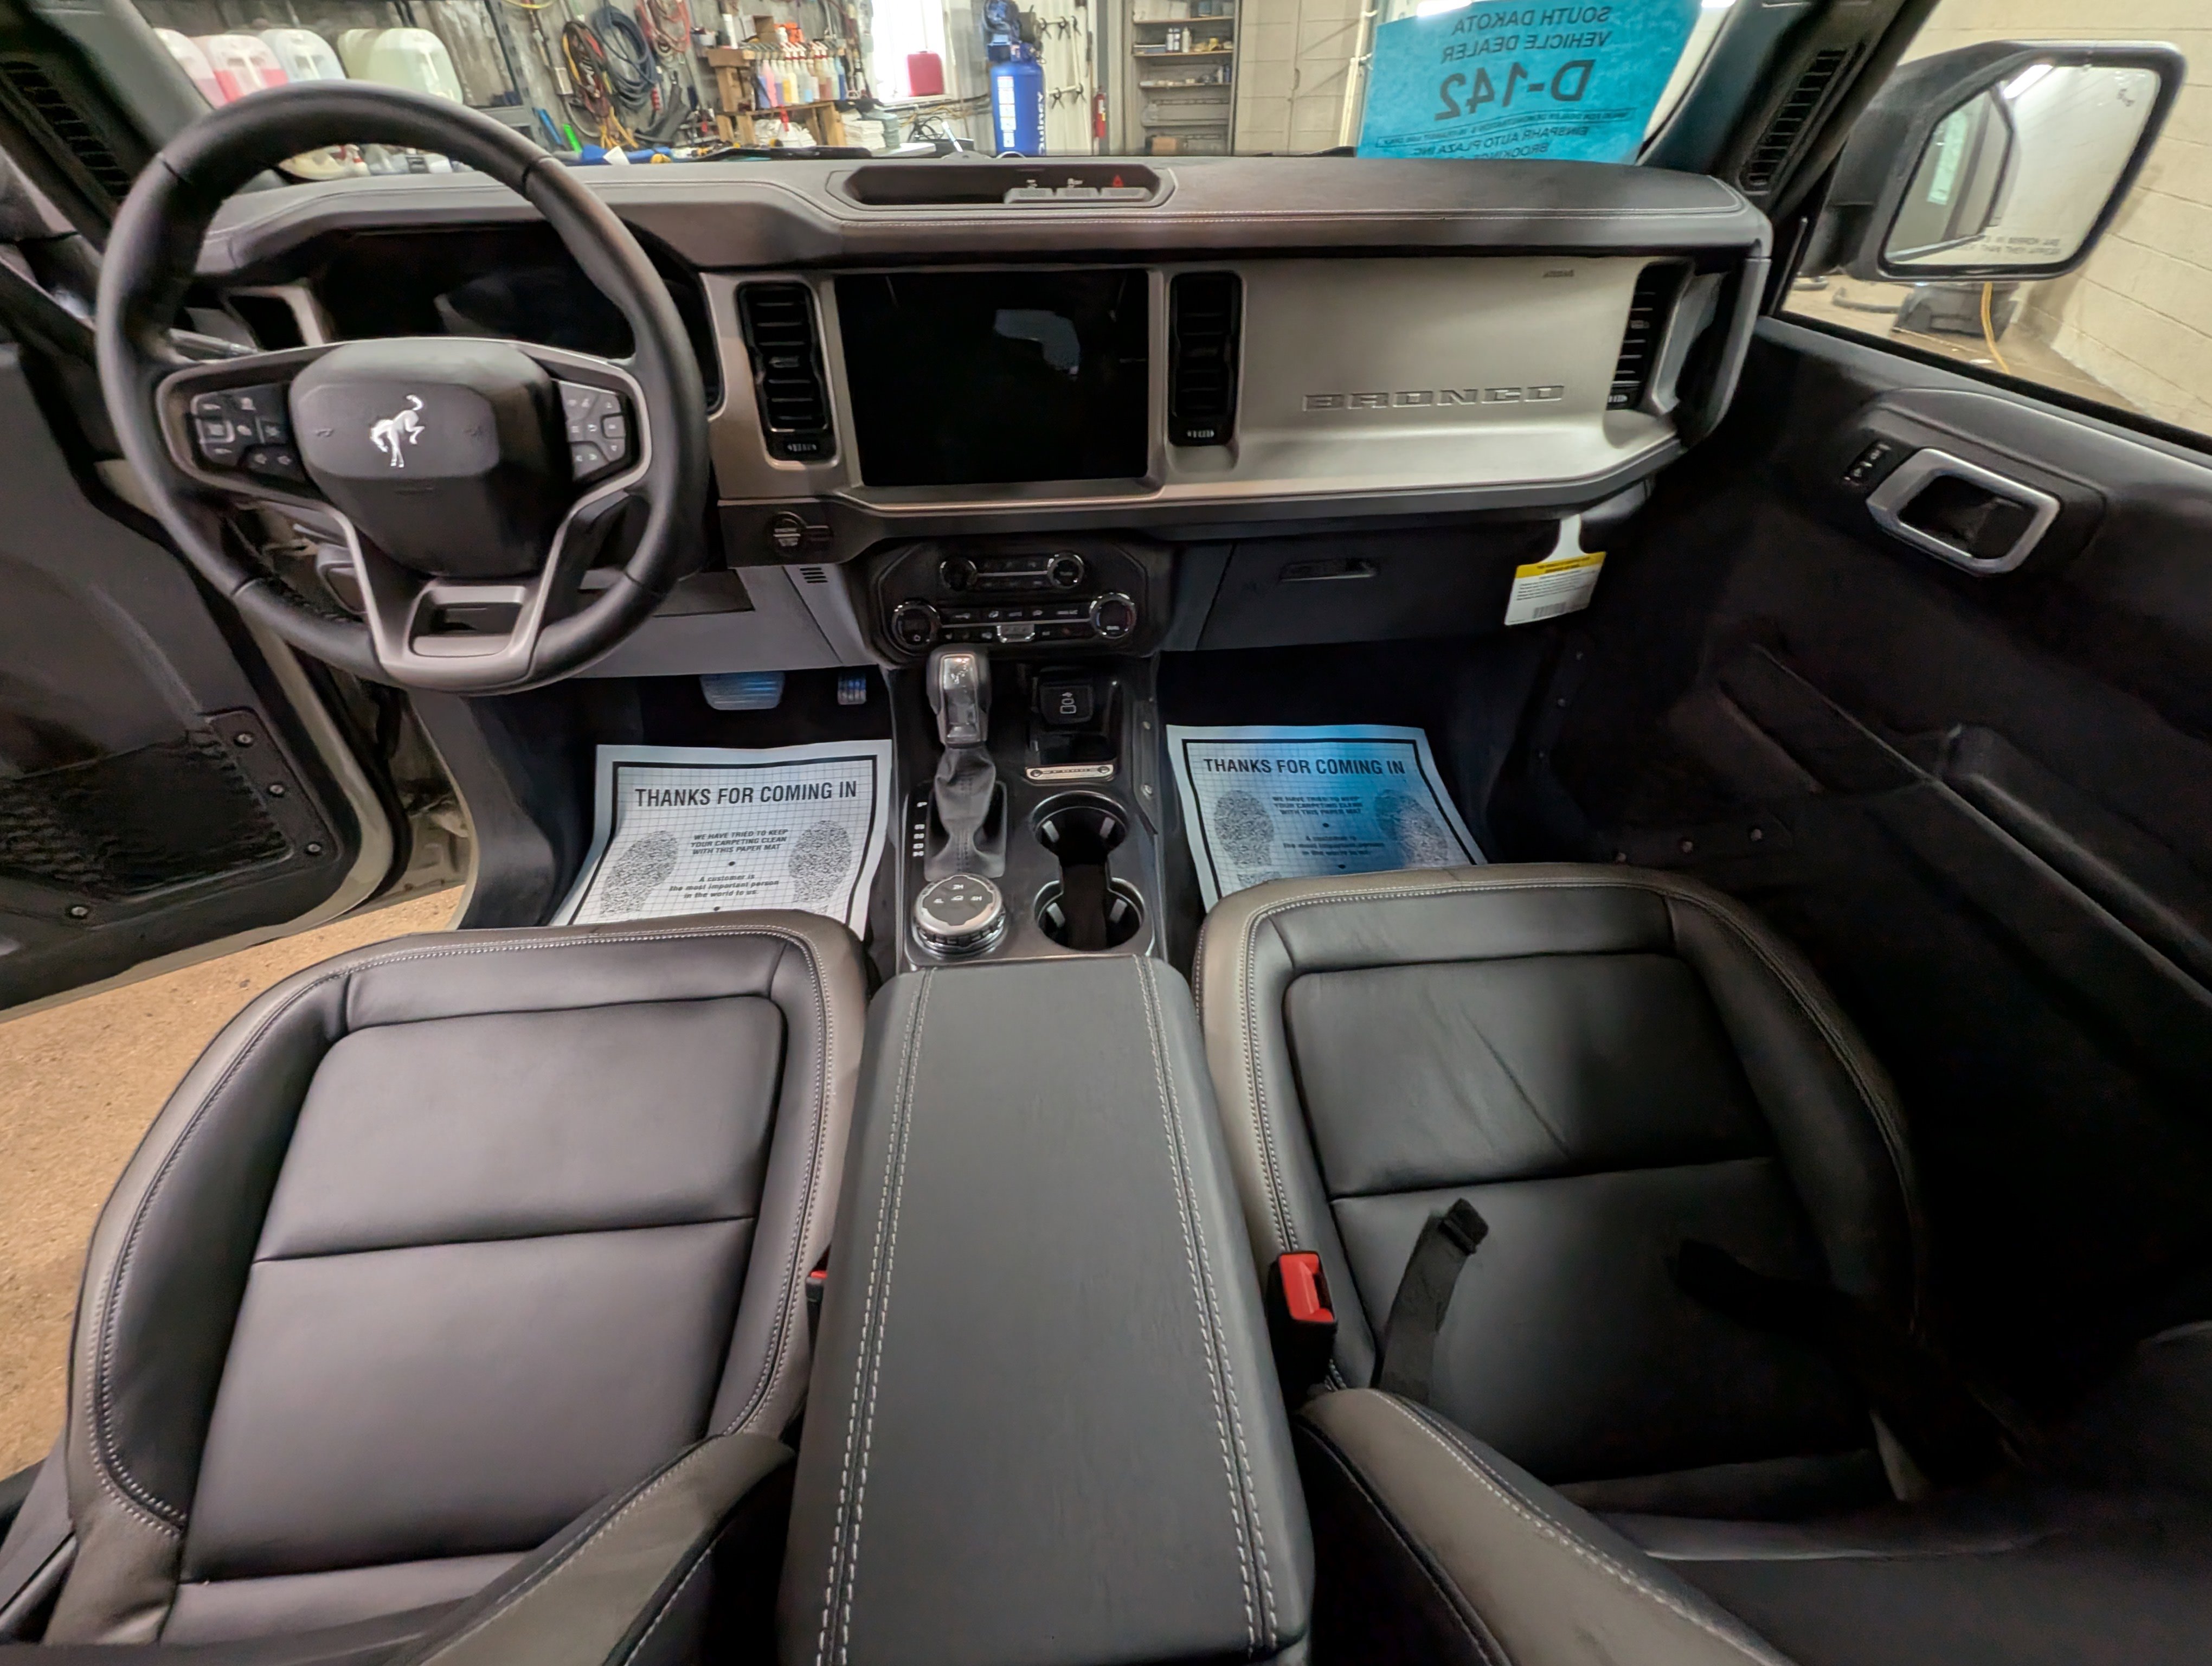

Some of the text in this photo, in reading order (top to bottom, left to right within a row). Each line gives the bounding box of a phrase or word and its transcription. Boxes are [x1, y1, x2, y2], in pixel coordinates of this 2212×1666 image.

[1302, 386, 1565, 411] BRONCO
[1203, 759, 1405, 774] THANKS FOR COMING IN
[635, 780, 857, 806] THANKS FOR COMING IN
[715, 838, 760, 846] CARPETING
[708, 882, 749, 890] important
[750, 880, 779, 888] person
